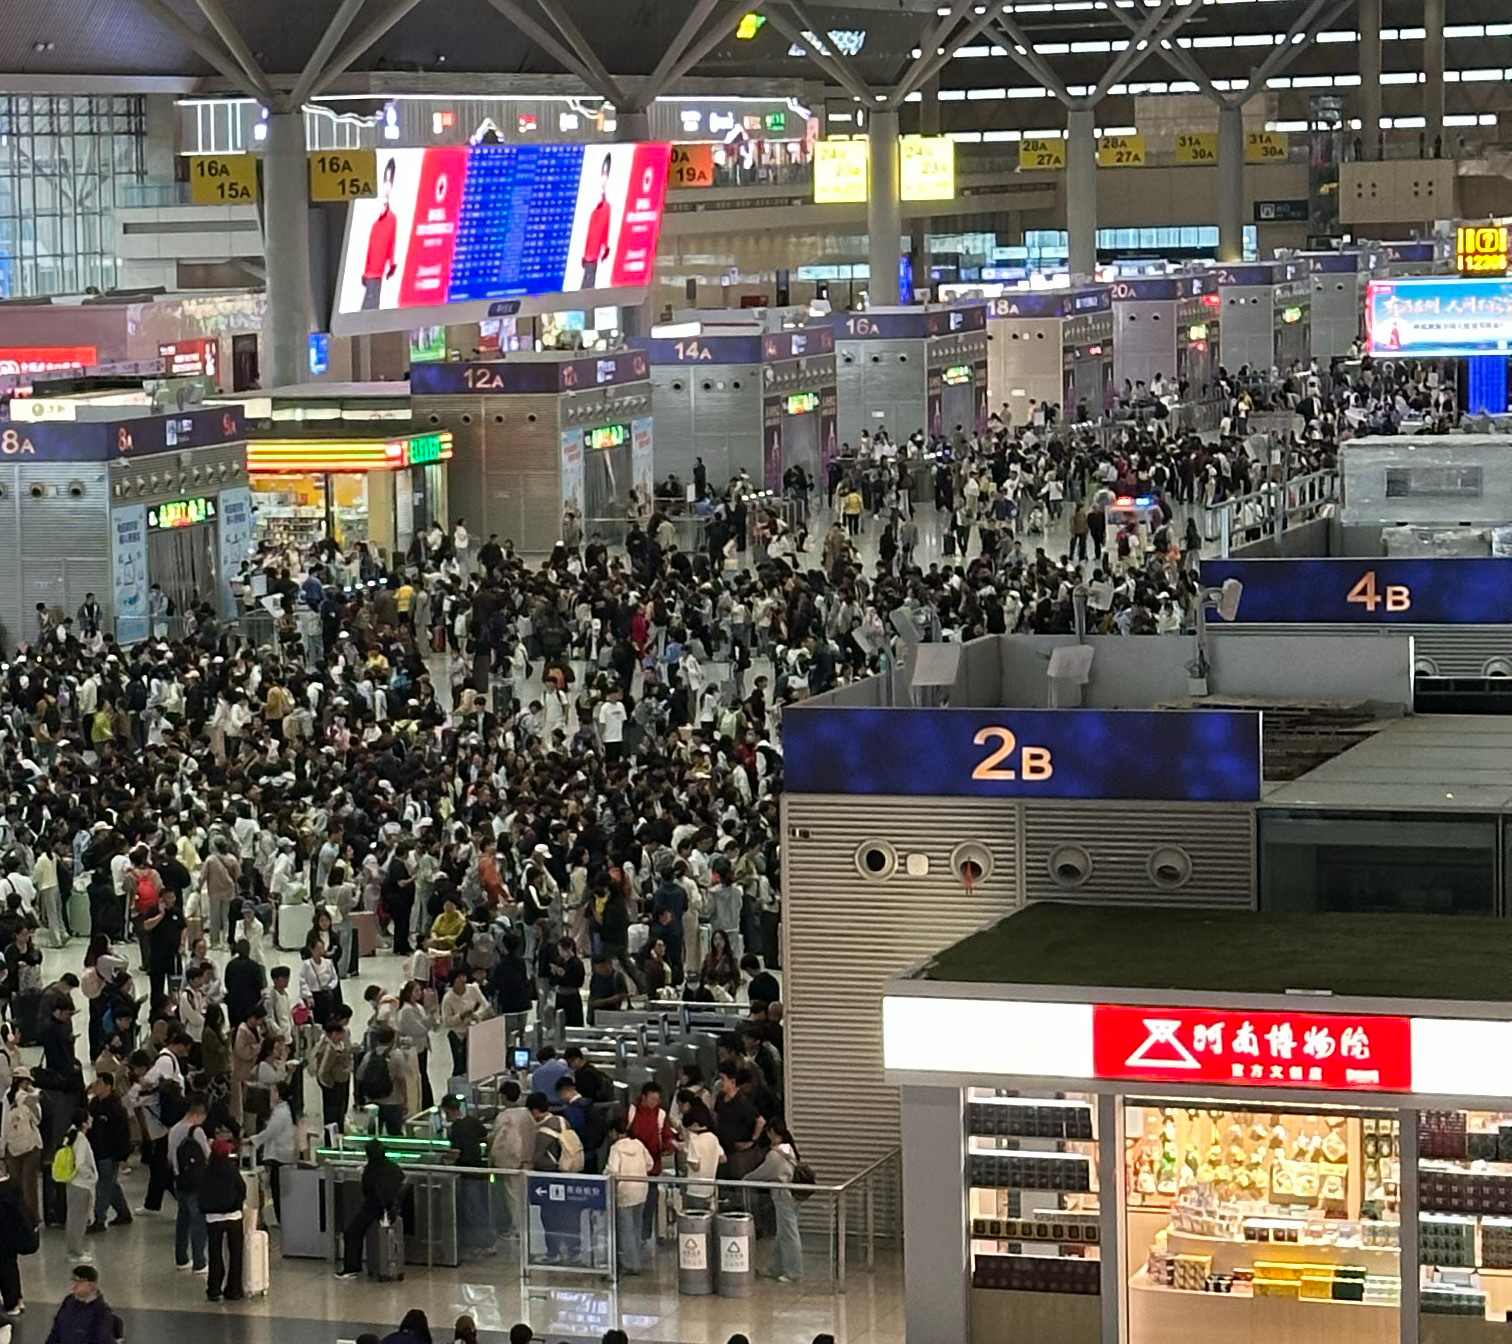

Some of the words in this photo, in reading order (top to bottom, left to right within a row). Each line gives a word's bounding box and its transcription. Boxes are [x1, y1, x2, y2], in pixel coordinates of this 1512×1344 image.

[1023, 140, 1047, 152] 28A
[1102, 138, 1127, 149] 28A
[317, 156, 353, 174] 16A
[670, 150, 690, 163] 0A
[1036, 154, 1062, 166] 27A
[1116, 151, 1141, 163] 27A
[196, 160, 230, 177] 16A
[676, 166, 707, 182] 19A
[217, 183, 251, 199] 15A
[337, 178, 373, 196] 15A
[988, 299, 1019, 315] 18A
[846, 318, 880, 336] 16A
[674, 340, 712, 361] 14A
[463, 368, 505, 389] 12A
[1, 429, 36, 454] 8A
[117, 426, 134, 451] 8A
[1347, 570, 1412, 613] 4B
[972, 725, 1054, 782] 2B
[1193, 1020, 1371, 1060] 河南博物院
